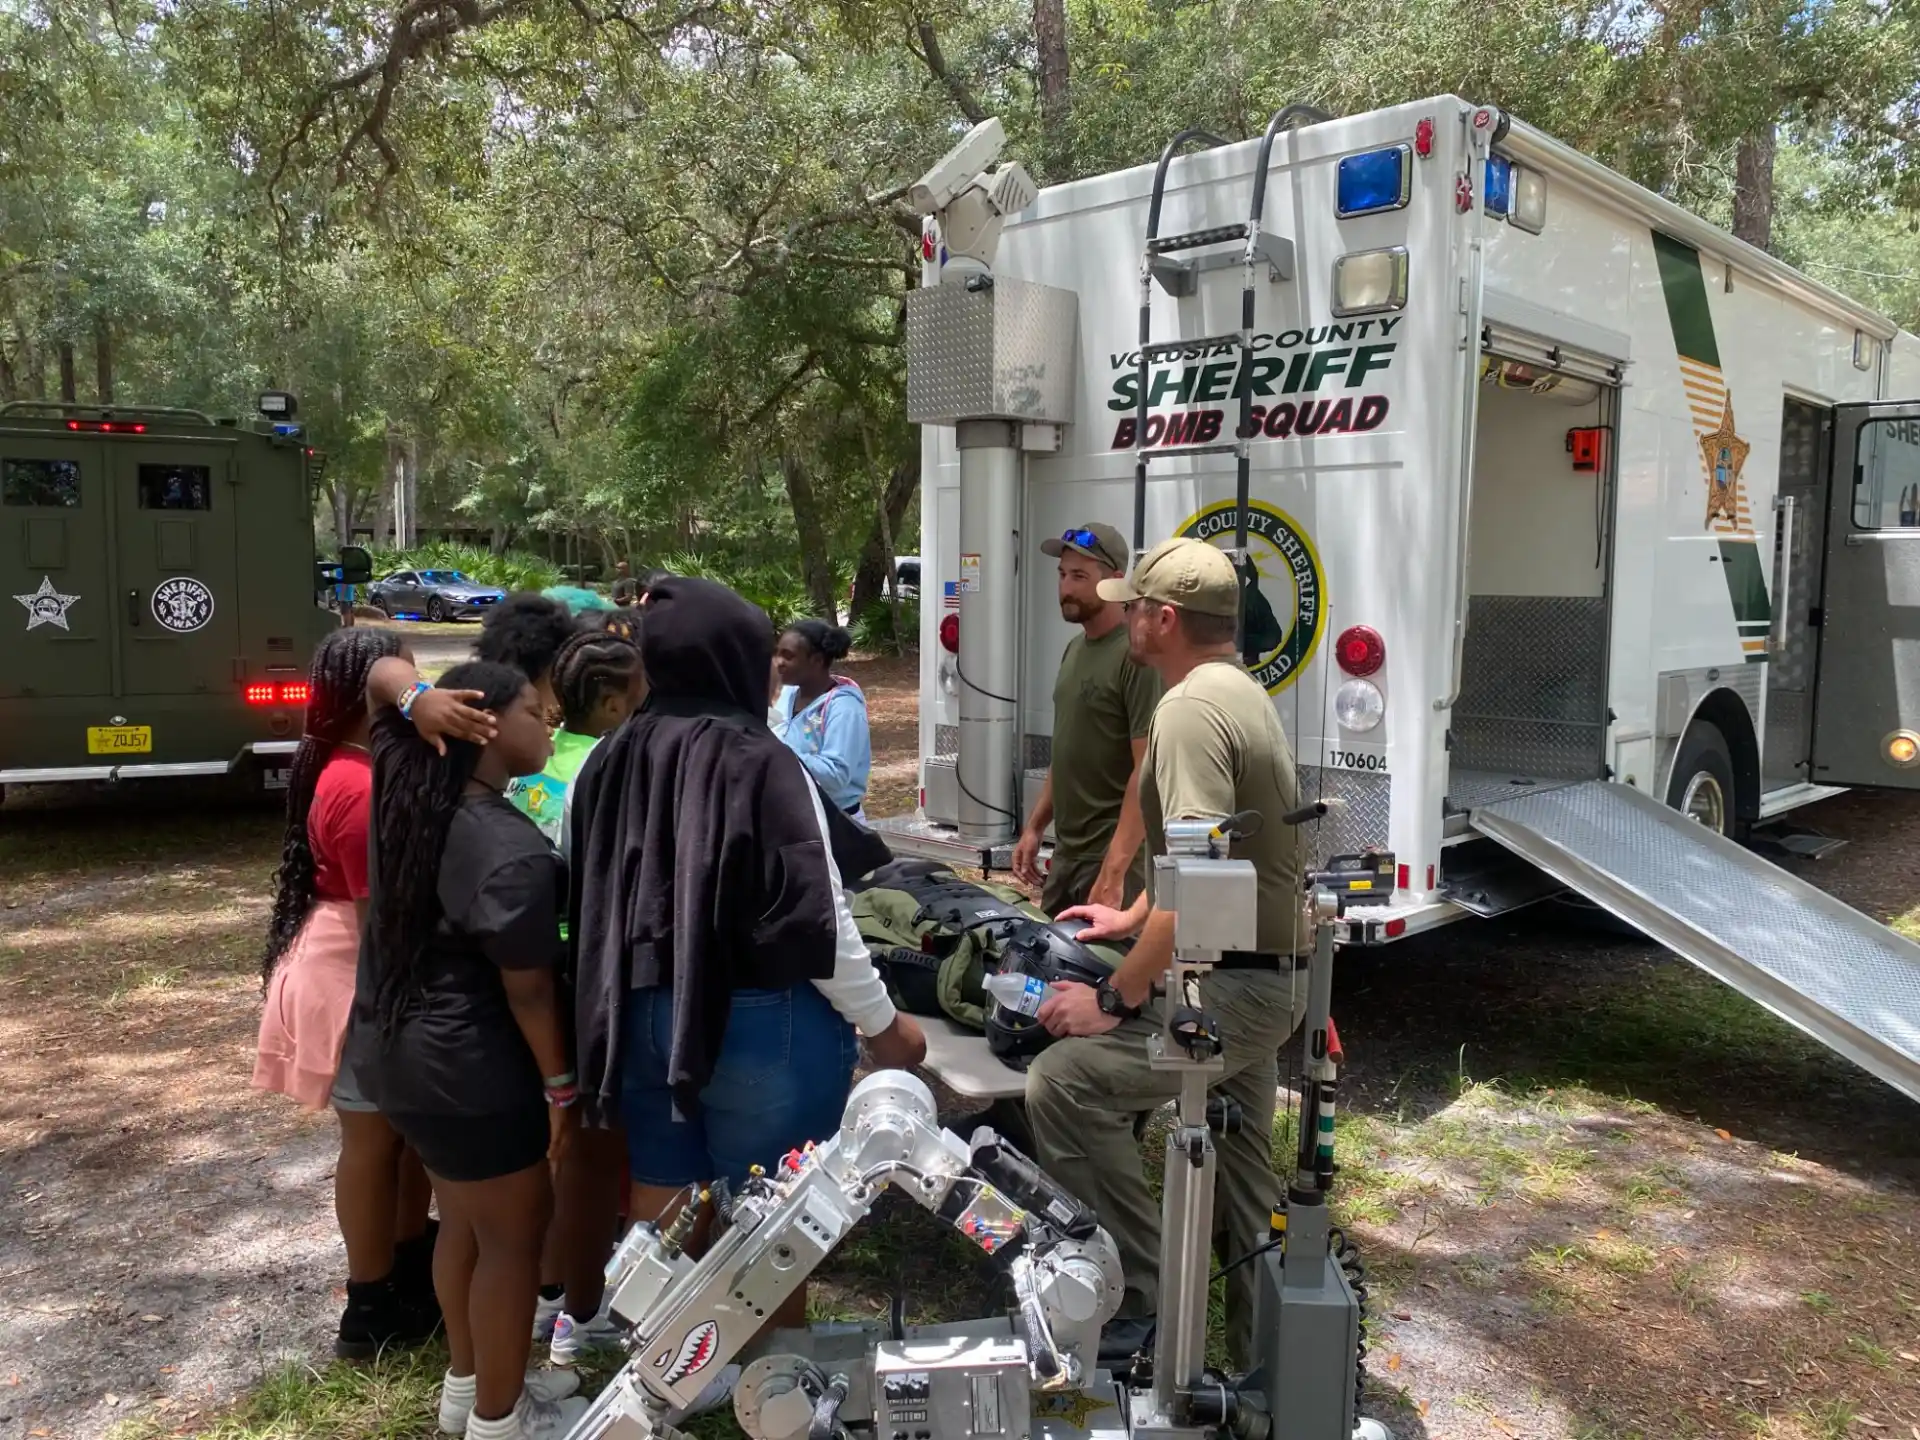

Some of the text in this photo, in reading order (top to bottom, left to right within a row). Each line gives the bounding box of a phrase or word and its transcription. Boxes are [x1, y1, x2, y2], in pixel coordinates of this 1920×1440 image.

[1250, 316, 1404, 352] COUNTY
[1107, 343, 1398, 412] SHERIFF
[1111, 395, 1390, 449] BOMB SQUAD
[1886, 420, 1920, 446] SHE
[1272, 527, 1315, 626] SHERIFF
[1255, 654, 1292, 686] UAD
[1330, 750, 1388, 772] 170604
